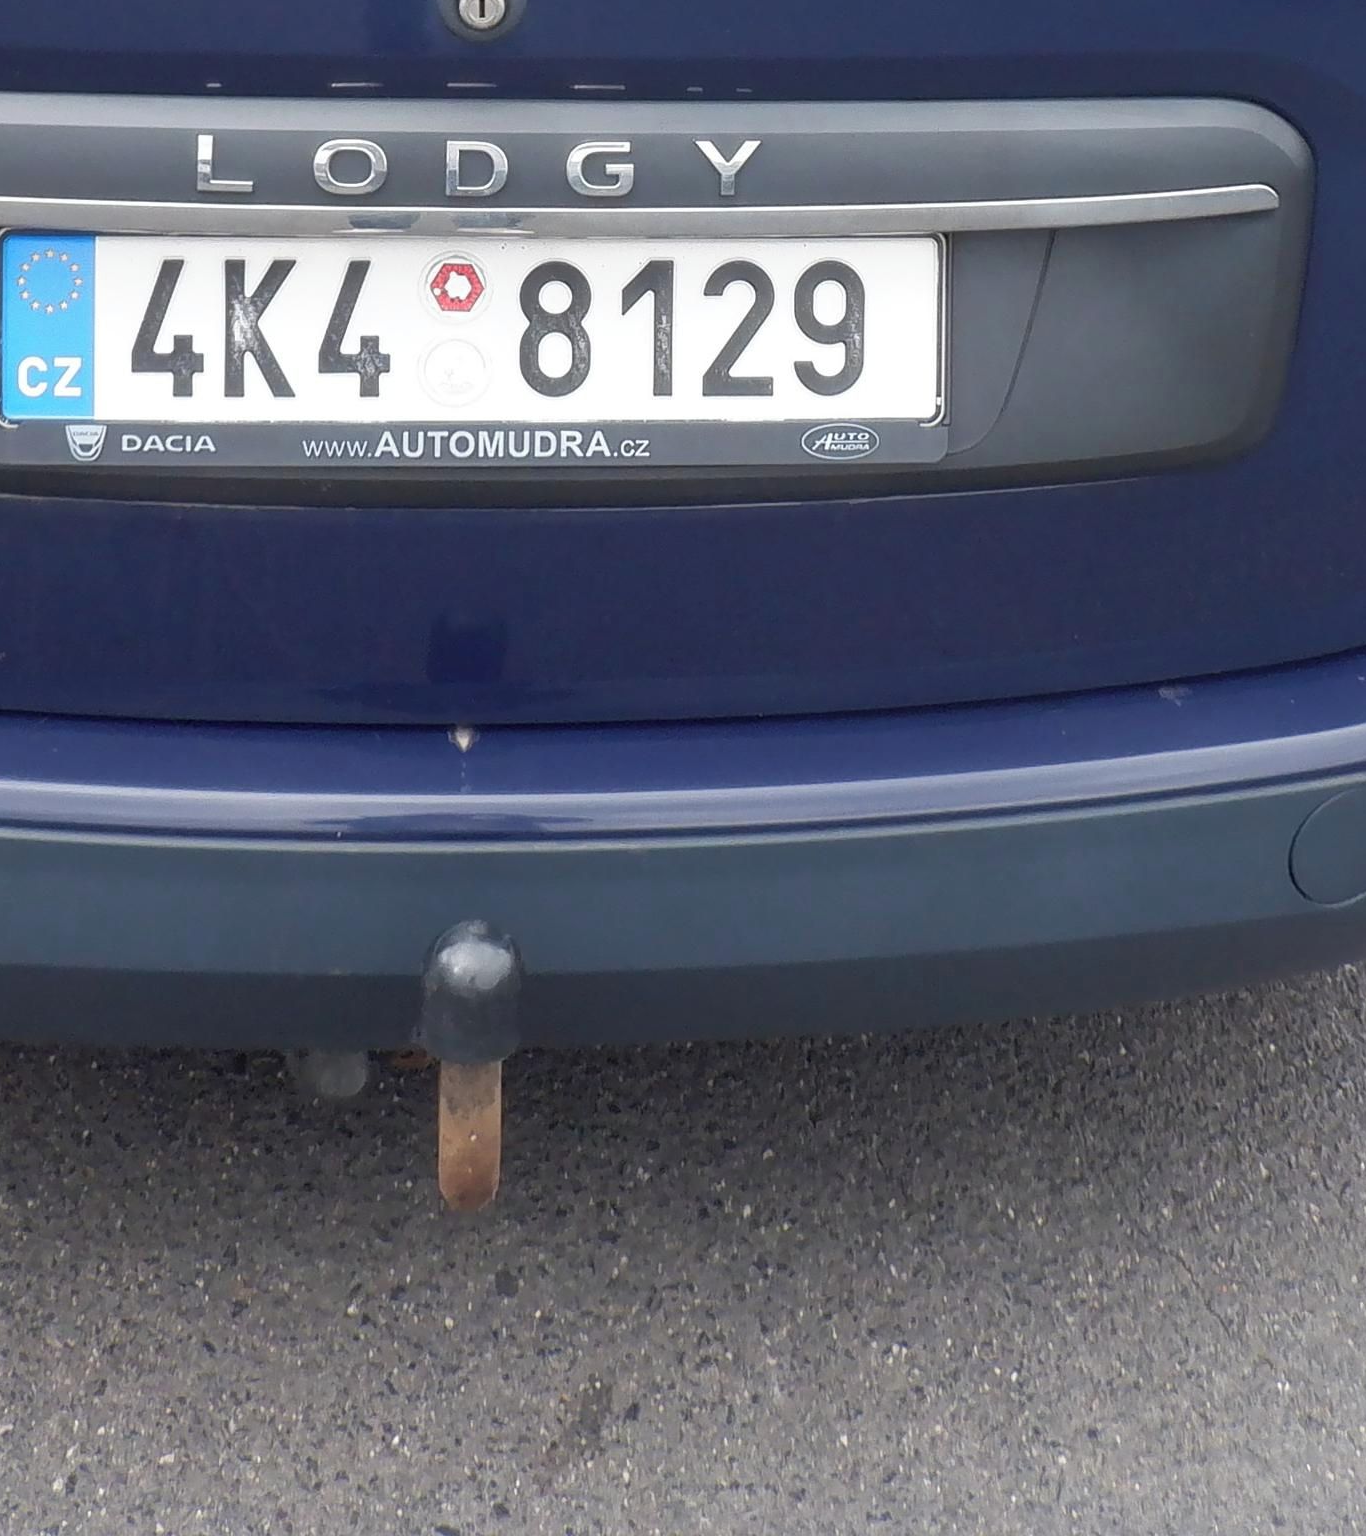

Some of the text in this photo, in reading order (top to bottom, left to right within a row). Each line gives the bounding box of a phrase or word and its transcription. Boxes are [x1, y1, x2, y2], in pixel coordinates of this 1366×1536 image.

[196, 134, 762, 197] LODGY
[131, 258, 866, 398] 4K4 8129
[17, 355, 82, 397] CZ
[121, 435, 216, 453] DACIA
[302, 430, 651, 458] www.AUTOMUDRA.cz
